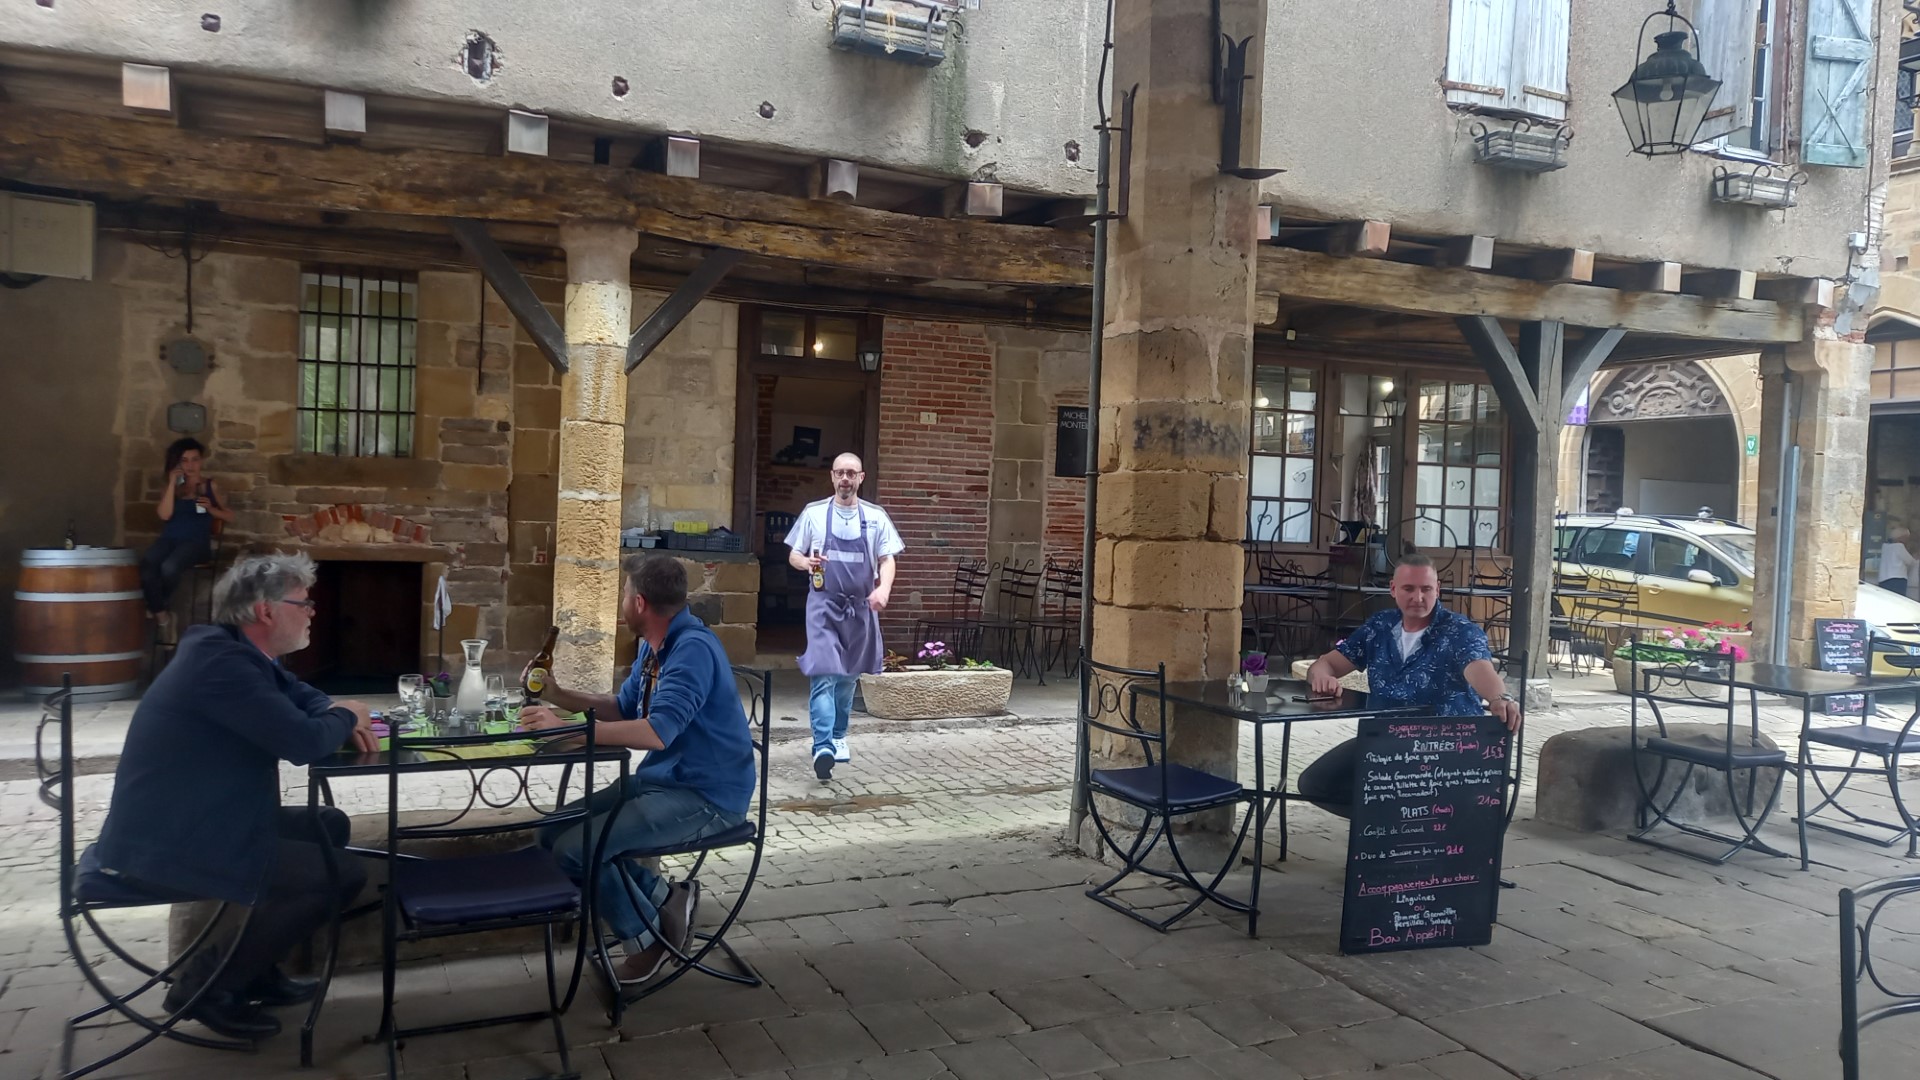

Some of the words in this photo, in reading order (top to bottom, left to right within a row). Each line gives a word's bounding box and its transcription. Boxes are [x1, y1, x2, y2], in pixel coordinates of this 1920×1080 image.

[1063, 411, 1088, 420] MICHEL
[1442, 723, 1452, 731] DU
[1455, 723, 1477, 731] JOUR
[1425, 730, 1438, 738] du
[1394, 753, 1403, 761] de
[1404, 752, 1420, 765] foie
[1423, 754, 1440, 765] gras
[1368, 770, 1392, 782] Salade
[1394, 770, 1433, 781] Gourmande
[1363, 782, 1372, 791] de
[1419, 779, 1428, 787] de
[1400, 806, 1429, 819] PLATS
[1363, 824, 1386, 838] Confit
[1390, 826, 1398, 835] de
[1401, 823, 1425, 834] Canard
[1360, 852, 1377, 860] Duo
[1379, 850, 1387, 859] de
[1442, 876, 1452, 884] au
[1396, 893, 1436, 906] Linguines
[1393, 911, 1420, 922] Pommes
[1430, 917, 1452, 926] Salade
